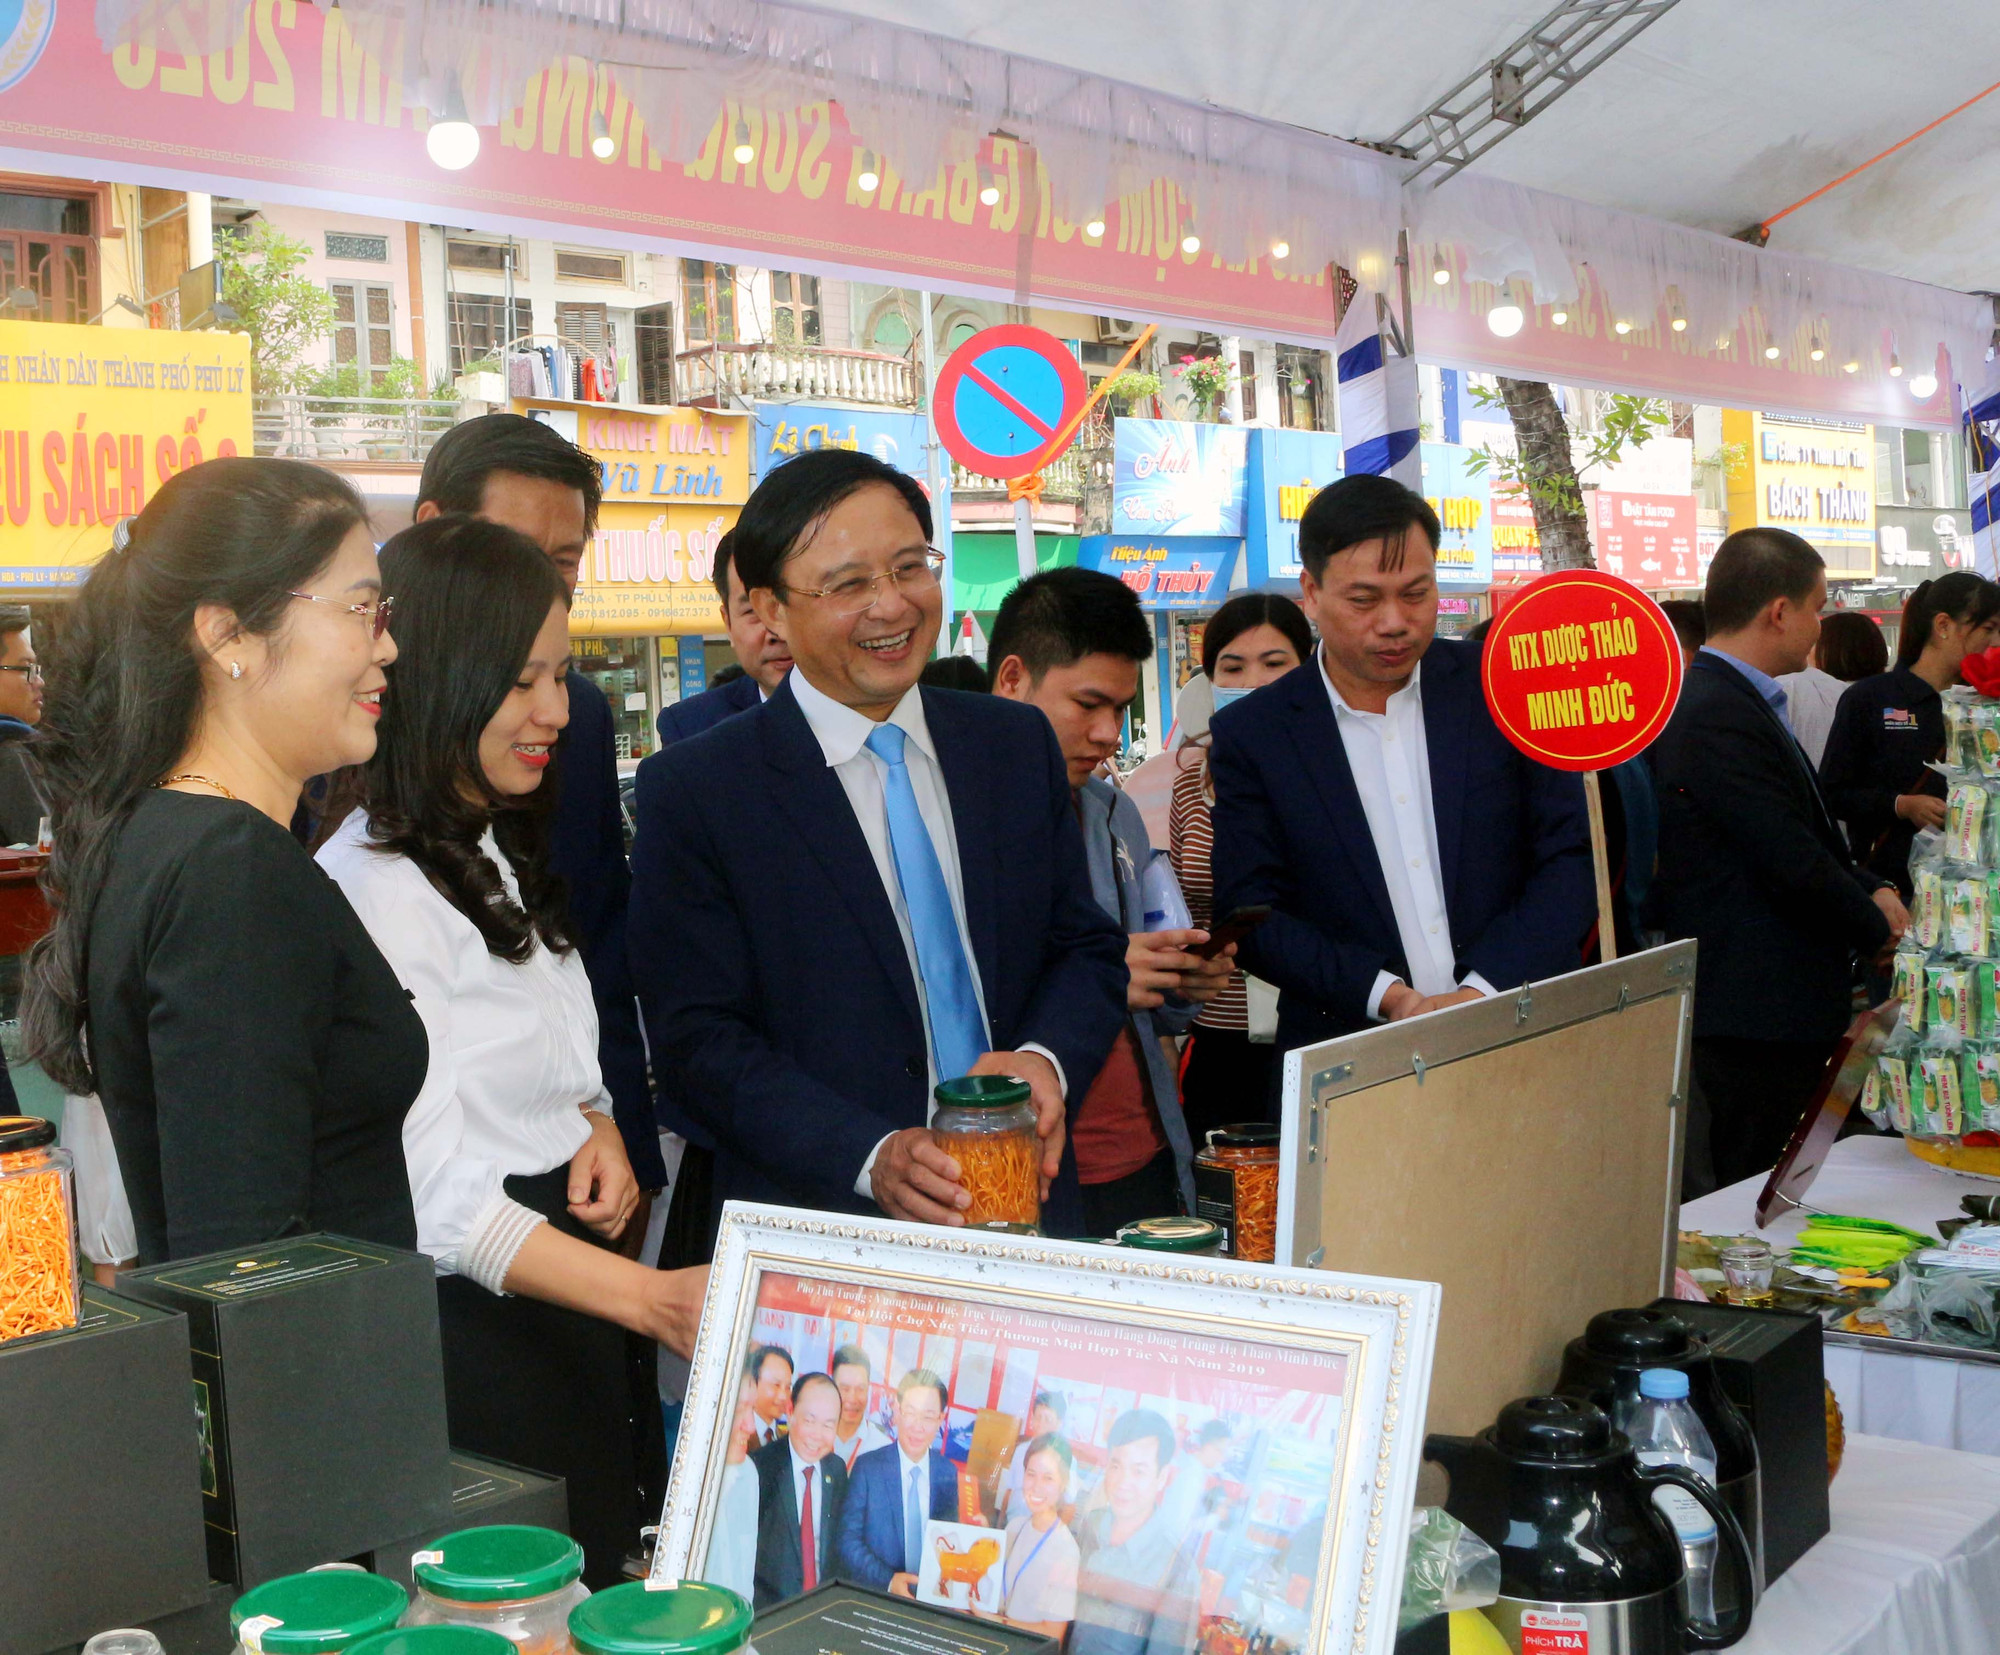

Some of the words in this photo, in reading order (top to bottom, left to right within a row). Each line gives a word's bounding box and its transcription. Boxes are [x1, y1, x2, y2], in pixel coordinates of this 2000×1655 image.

[16, 350, 61, 384] NHÂN
[67, 352, 97, 386] DÂN
[104, 354, 155, 389] THÀNH
[161, 352, 191, 390] PHỐ
[195, 355, 223, 392] PHỦ
[227, 361, 244, 393] LÝ
[587, 410, 658, 453] KÍNH
[43, 412, 146, 527] SÁCH
[601, 461, 640, 493] Vũ
[651, 463, 723, 497] Lĩnh
[1443, 495, 1484, 537] HỢP
[1767, 477, 1811, 518] BÁCH
[593, 515, 683, 583] THUỐC
[616, 593, 630, 603] TP
[1156, 561, 1215, 593] THỦY
[1508, 632, 1542, 671] HTX
[1541, 623, 1589, 672] DƯỢC
[1589, 602, 1638, 660] THẢO
[1526, 688, 1585, 731] MINH
[1587, 672, 1636, 725] ĐỨC
[1018, 1314, 1048, 1329] Tham
[1052, 1319, 1081, 1334] Quan
[994, 1327, 1049, 1347] Thương
[1054, 1336, 1083, 1352] Mại
[1184, 1355, 1222, 1372] Năm
[1227, 1362, 1266, 1378] 2019
[1525, 1635, 1554, 1647] PHÍCH
[1554, 1633, 1583, 1648] TRÀ
